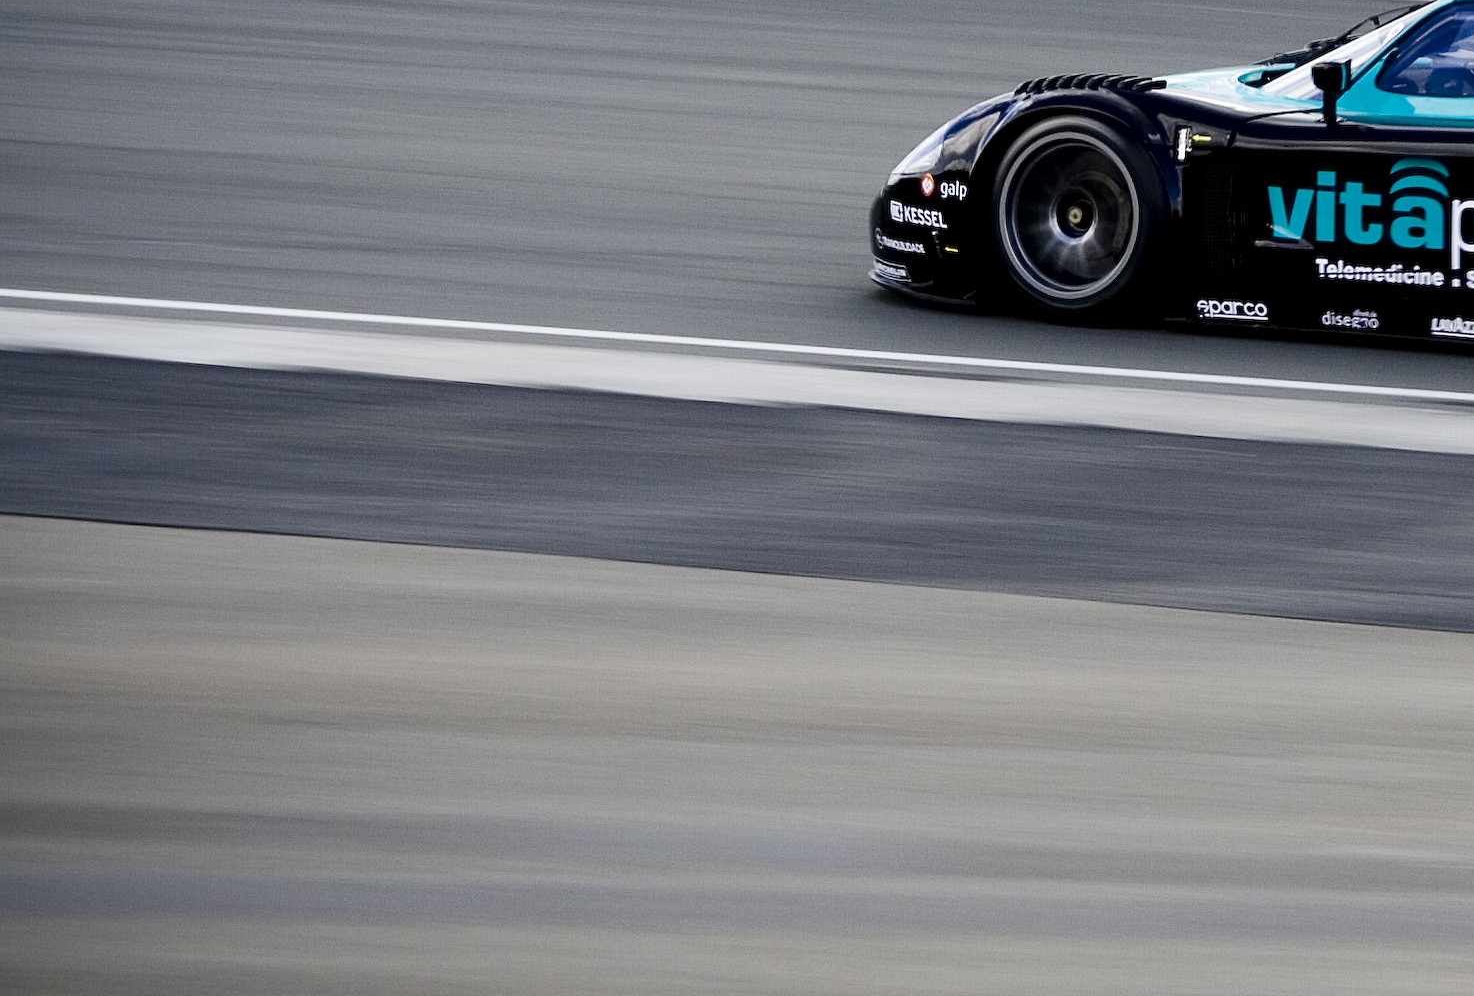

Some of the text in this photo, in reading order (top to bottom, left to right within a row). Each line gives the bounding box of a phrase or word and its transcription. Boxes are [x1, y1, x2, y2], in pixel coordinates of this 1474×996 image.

[940, 180, 967, 201] galp
[904, 205, 948, 229] KESSEL
[1315, 258, 1444, 286] Telemedicine
[1197, 300, 1268, 318] sparco
